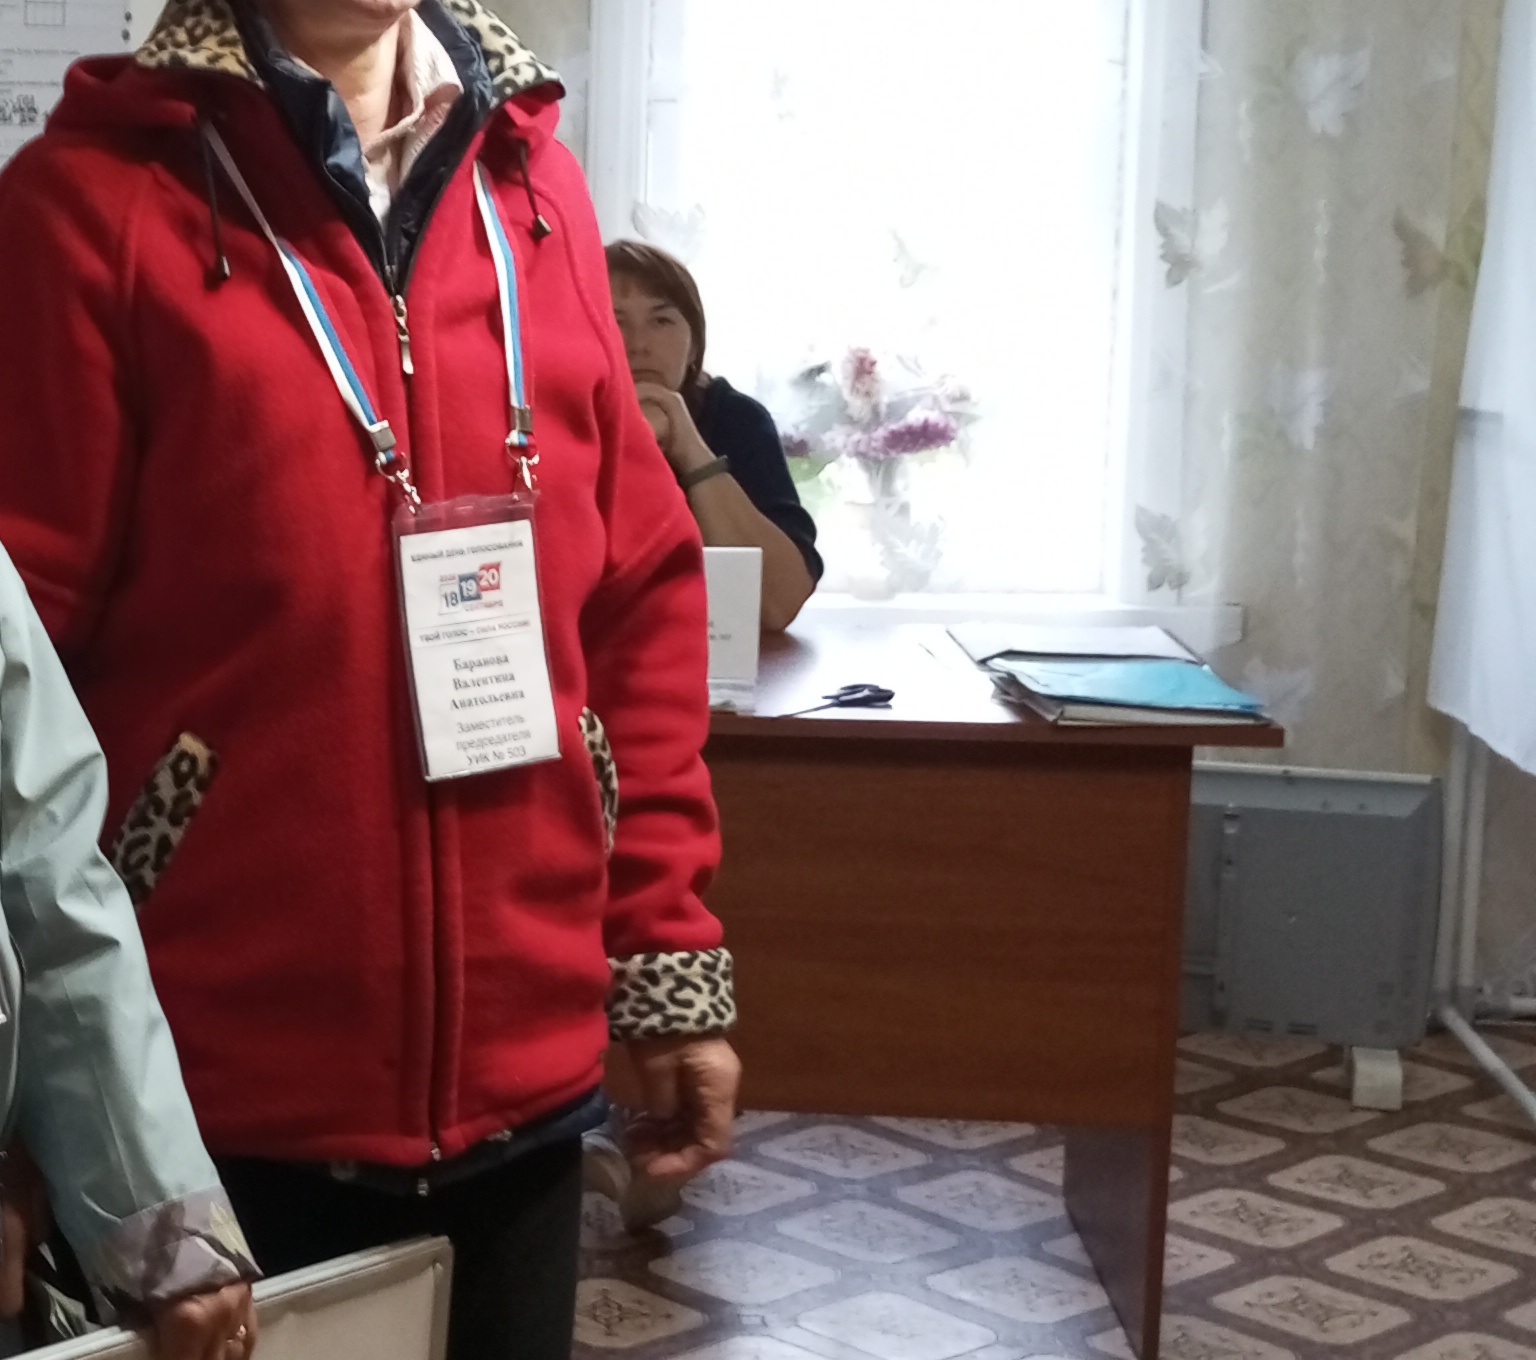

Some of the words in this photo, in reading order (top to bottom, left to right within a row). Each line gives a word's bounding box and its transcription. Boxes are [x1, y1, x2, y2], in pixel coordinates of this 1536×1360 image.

[479, 568, 498, 588] 20
[460, 579, 477, 597] 19
[443, 592, 459, 608] 18
[452, 672, 516, 690] Валентина
[450, 689, 525, 710] Анатольевна
